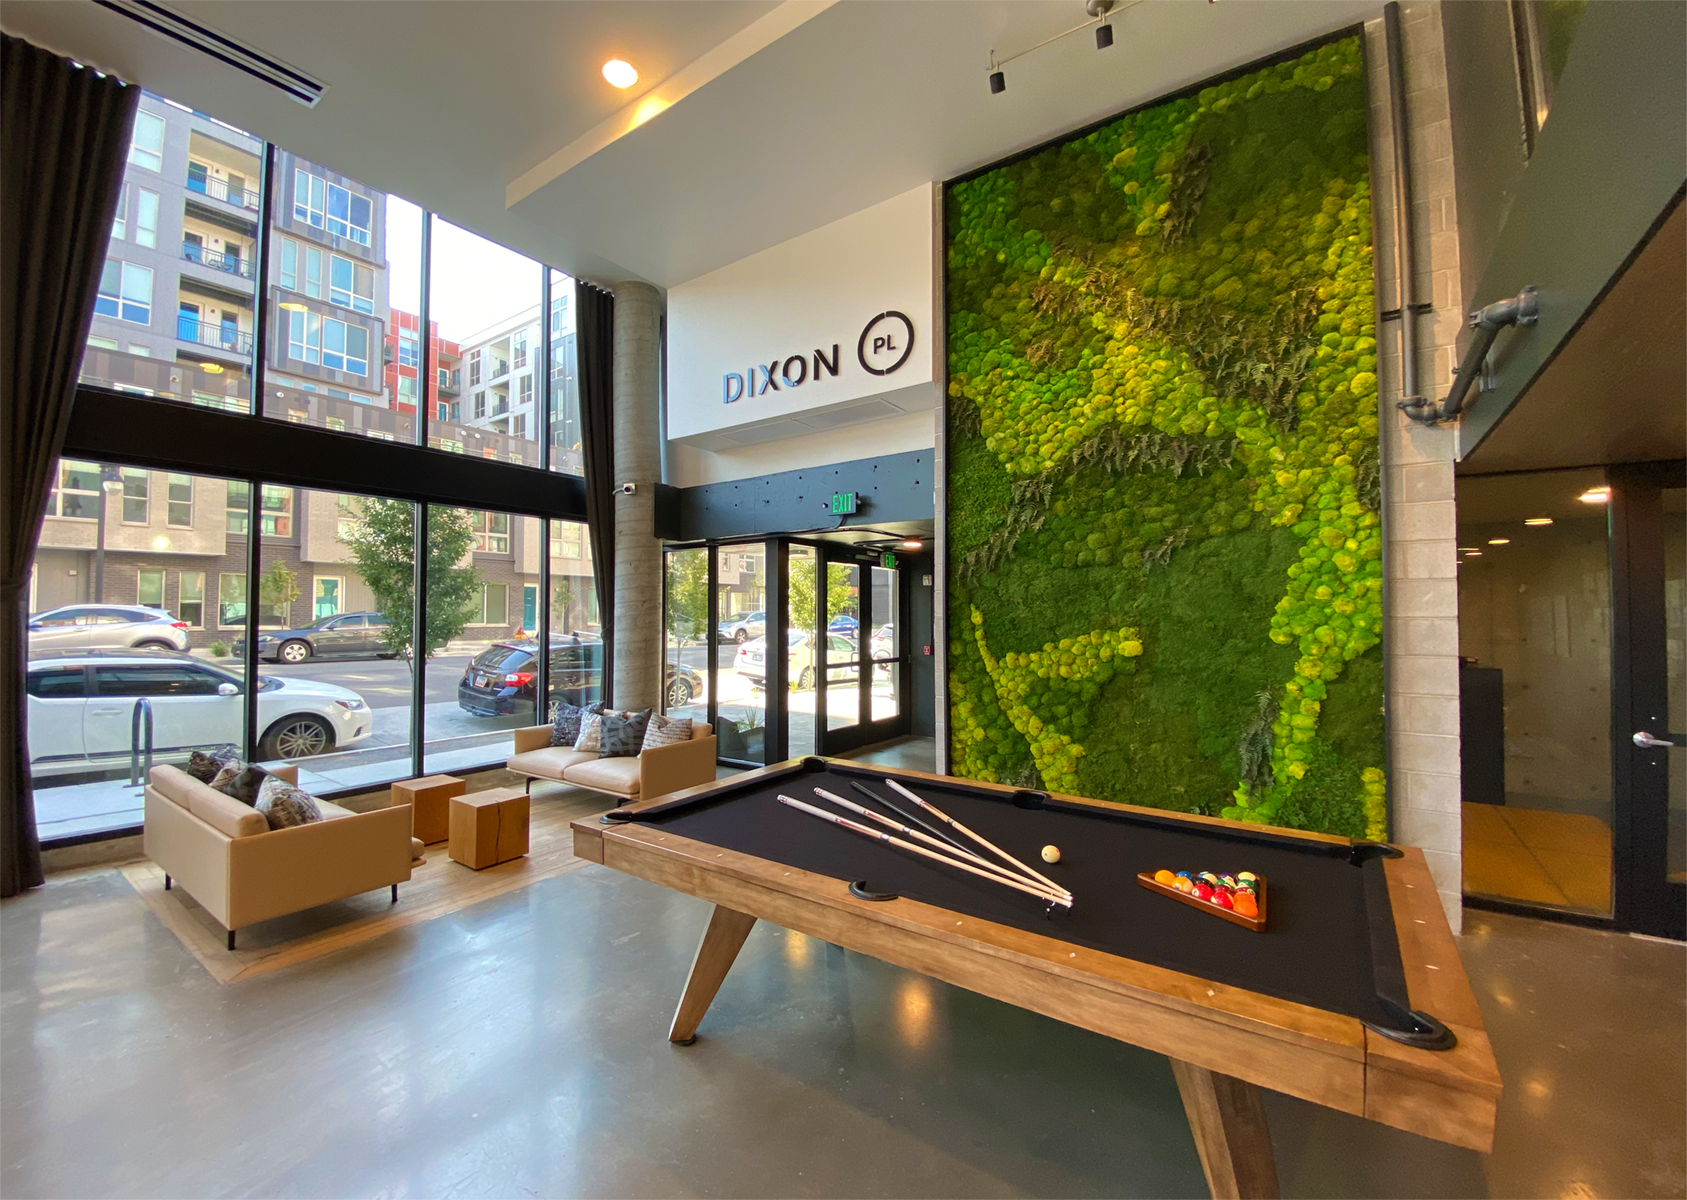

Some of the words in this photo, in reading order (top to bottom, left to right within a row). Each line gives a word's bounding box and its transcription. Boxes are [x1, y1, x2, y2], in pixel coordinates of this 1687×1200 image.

[873, 335, 896, 354] PL
[723, 344, 839, 403] DIXON
[832, 493, 853, 513] EXIT
